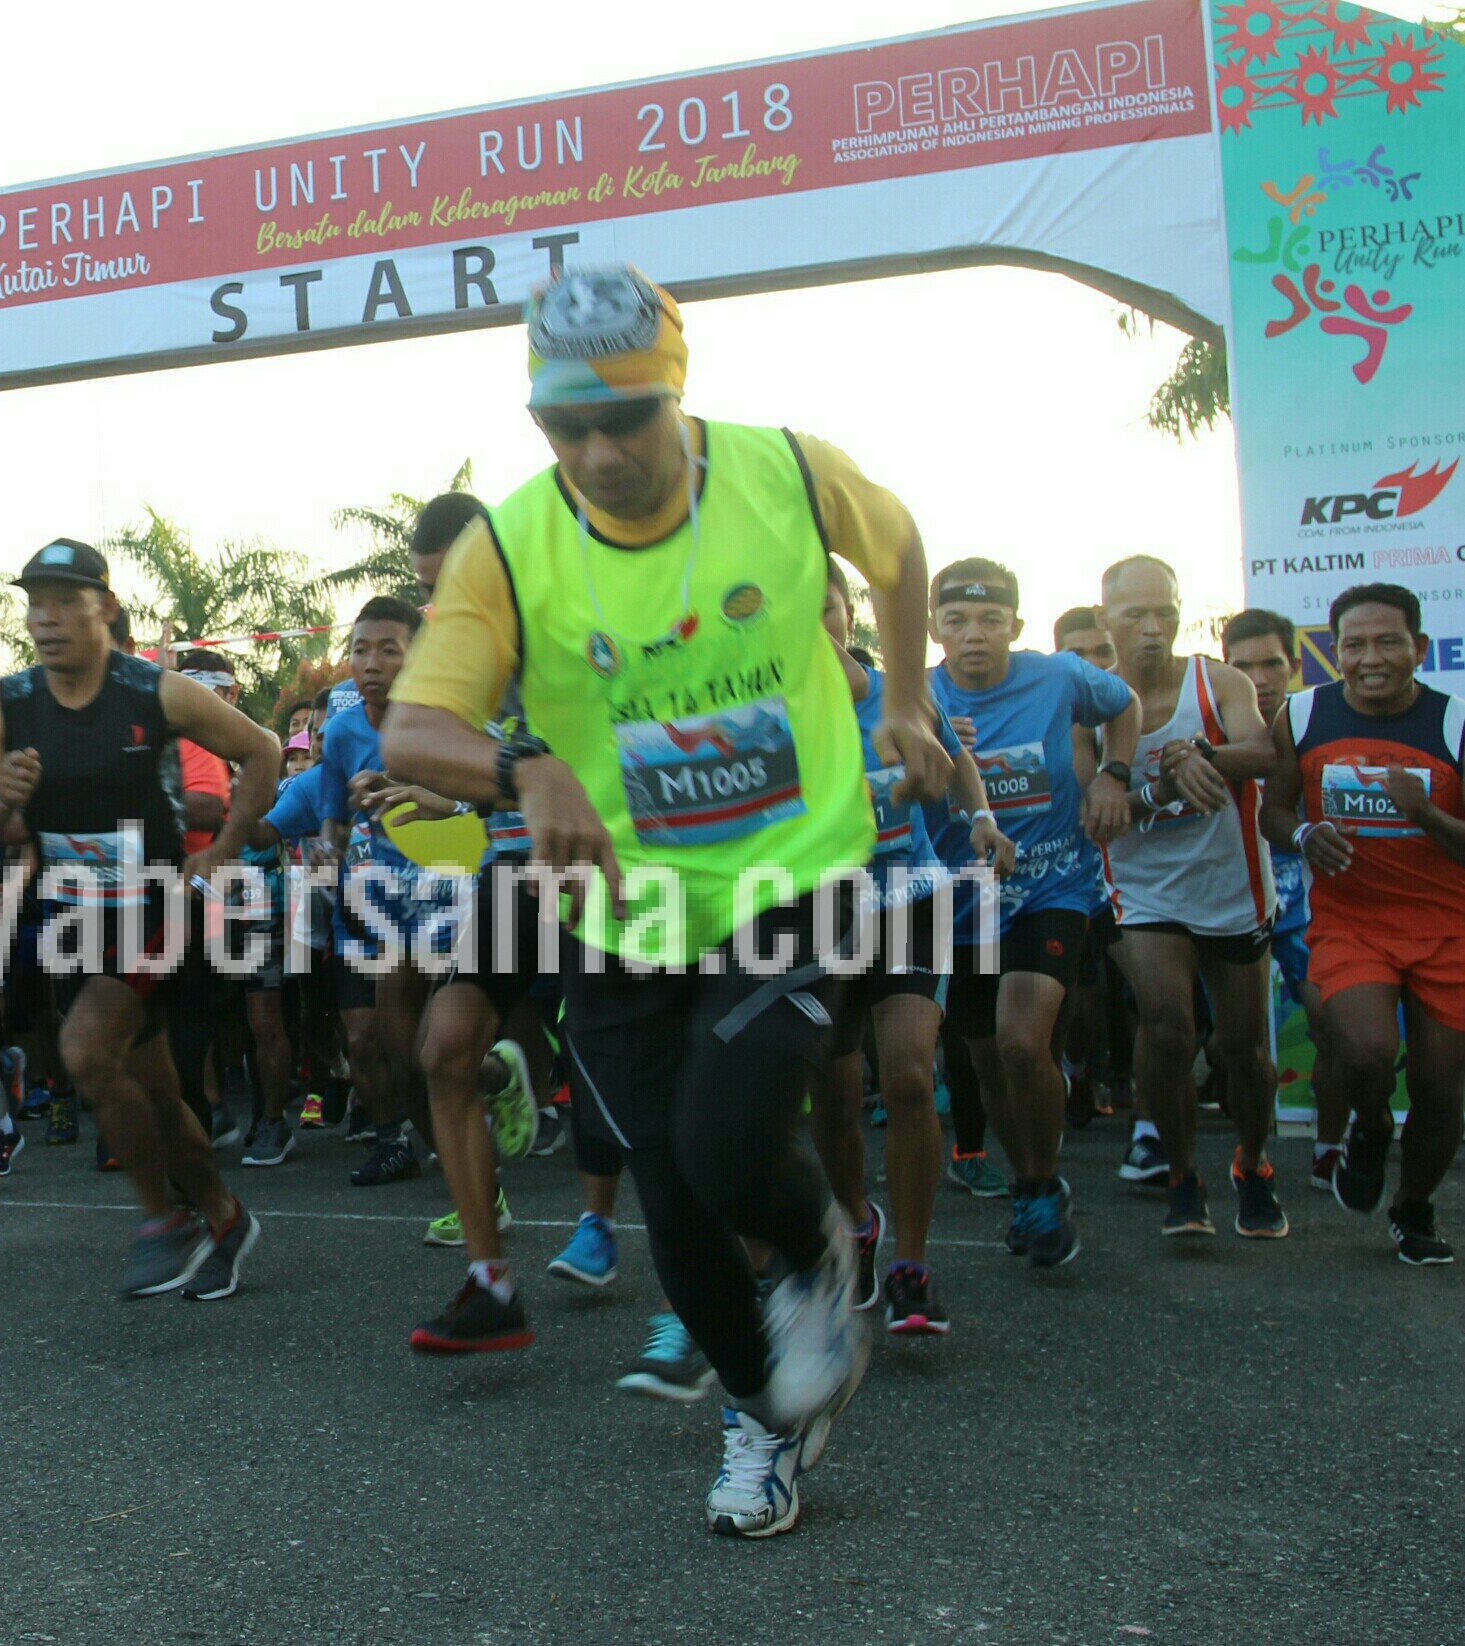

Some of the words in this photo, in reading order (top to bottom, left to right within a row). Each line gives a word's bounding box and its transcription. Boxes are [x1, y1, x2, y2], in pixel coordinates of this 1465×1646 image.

[854, 34, 1165, 133] PERHAPI
[832, 125, 939, 151] PERHIMPUNAN
[943, 118, 976, 134] AHLI
[979, 100, 1104, 129] PERTAMBANGAN
[1107, 86, 1193, 110] INDONESIA
[834, 140, 919, 163] ASSOCIATION
[921, 138, 939, 150] OF
[942, 126, 1026, 147] INDONESIAN
[1028, 117, 1081, 134] MINING
[1085, 100, 1194, 126] PROFESSIONALS
[254, 141, 427, 212] UNITY
[479, 116, 583, 177] RUN
[637, 83, 794, 153] 2018
[256, 222, 340, 254] Bersatu
[347, 201, 421, 238] dalam
[429, 186, 581, 227] Keberagaman
[581, 172, 615, 203] di
[623, 164, 683, 198] Kota
[690, 143, 802, 188] Tambang
[1317, 212, 1465, 253] PERHAPI
[61, 252, 150, 290] Timur
[1334, 241, 1405, 280] Unity
[1413, 235, 1462, 269] Run
[210, 232, 580, 344] START
[1283, 440, 1373, 458] PLATINUM
[1297, 528, 1325, 538] COAL
[1329, 526, 1361, 537] FROM
[1363, 521, 1425, 534] INDONESIA
[1300, 491, 1397, 525] KPC
[1251, 558, 1277, 576] PT
[1284, 553, 1364, 574] KALTIM
[1373, 546, 1451, 568] PRIMA
[655, 756, 768, 805] M1005
[1344, 792, 1397, 814] M102
